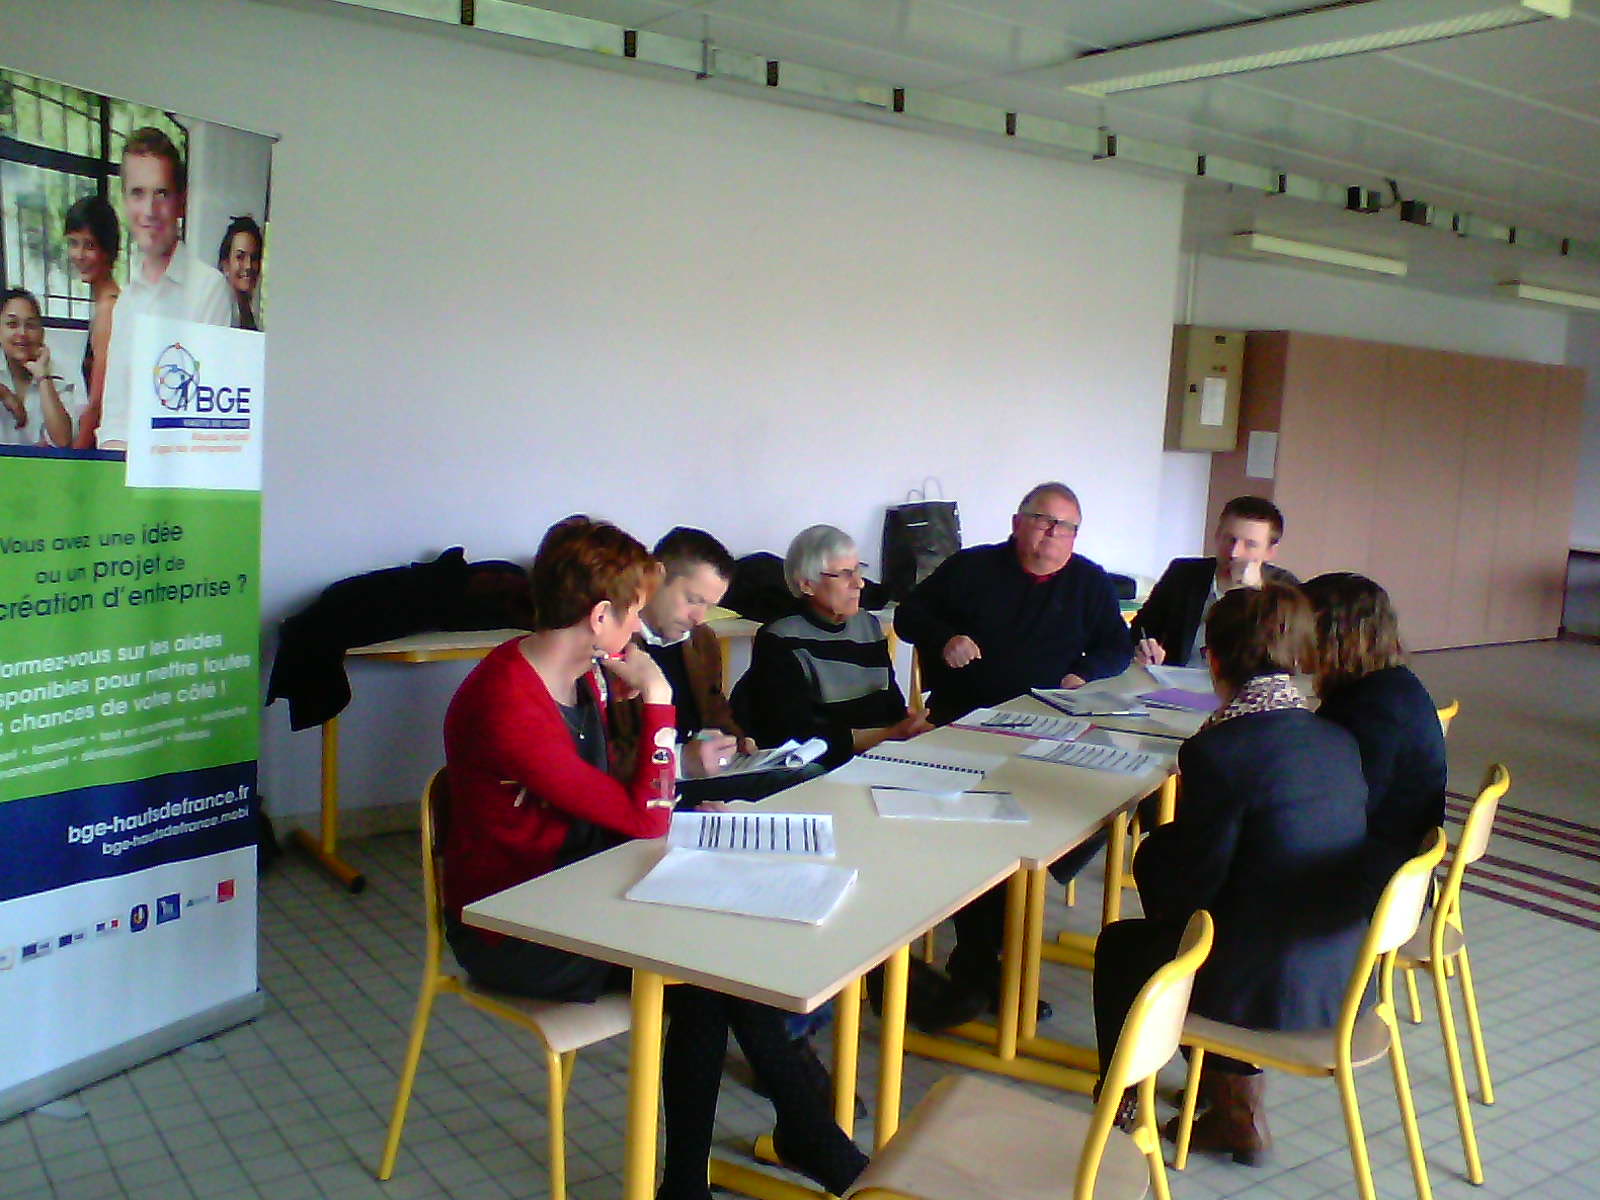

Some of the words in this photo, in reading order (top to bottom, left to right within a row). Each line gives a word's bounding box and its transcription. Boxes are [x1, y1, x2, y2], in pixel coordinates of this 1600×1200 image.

[196, 386, 251, 413] BGE
[52, 535, 91, 552] avez
[100, 532, 135, 547] une
[142, 522, 183, 545] idée
[35, 571, 61, 584] ou
[66, 567, 85, 582] un
[93, 554, 161, 582] projet
[165, 557, 185, 572] de
[0, 591, 94, 621] création
[118, 644, 146, 662] sur
[150, 640, 170, 656] les
[175, 632, 223, 652] aides
[95, 672, 141, 695] pour
[146, 661, 199, 683] mettre
[203, 653, 251, 673] toutes
[10, 703, 95, 734] chances
[101, 697, 128, 717] de
[134, 691, 172, 712] votre
[67, 785, 250, 844] bge-hautsdefrance.fr
